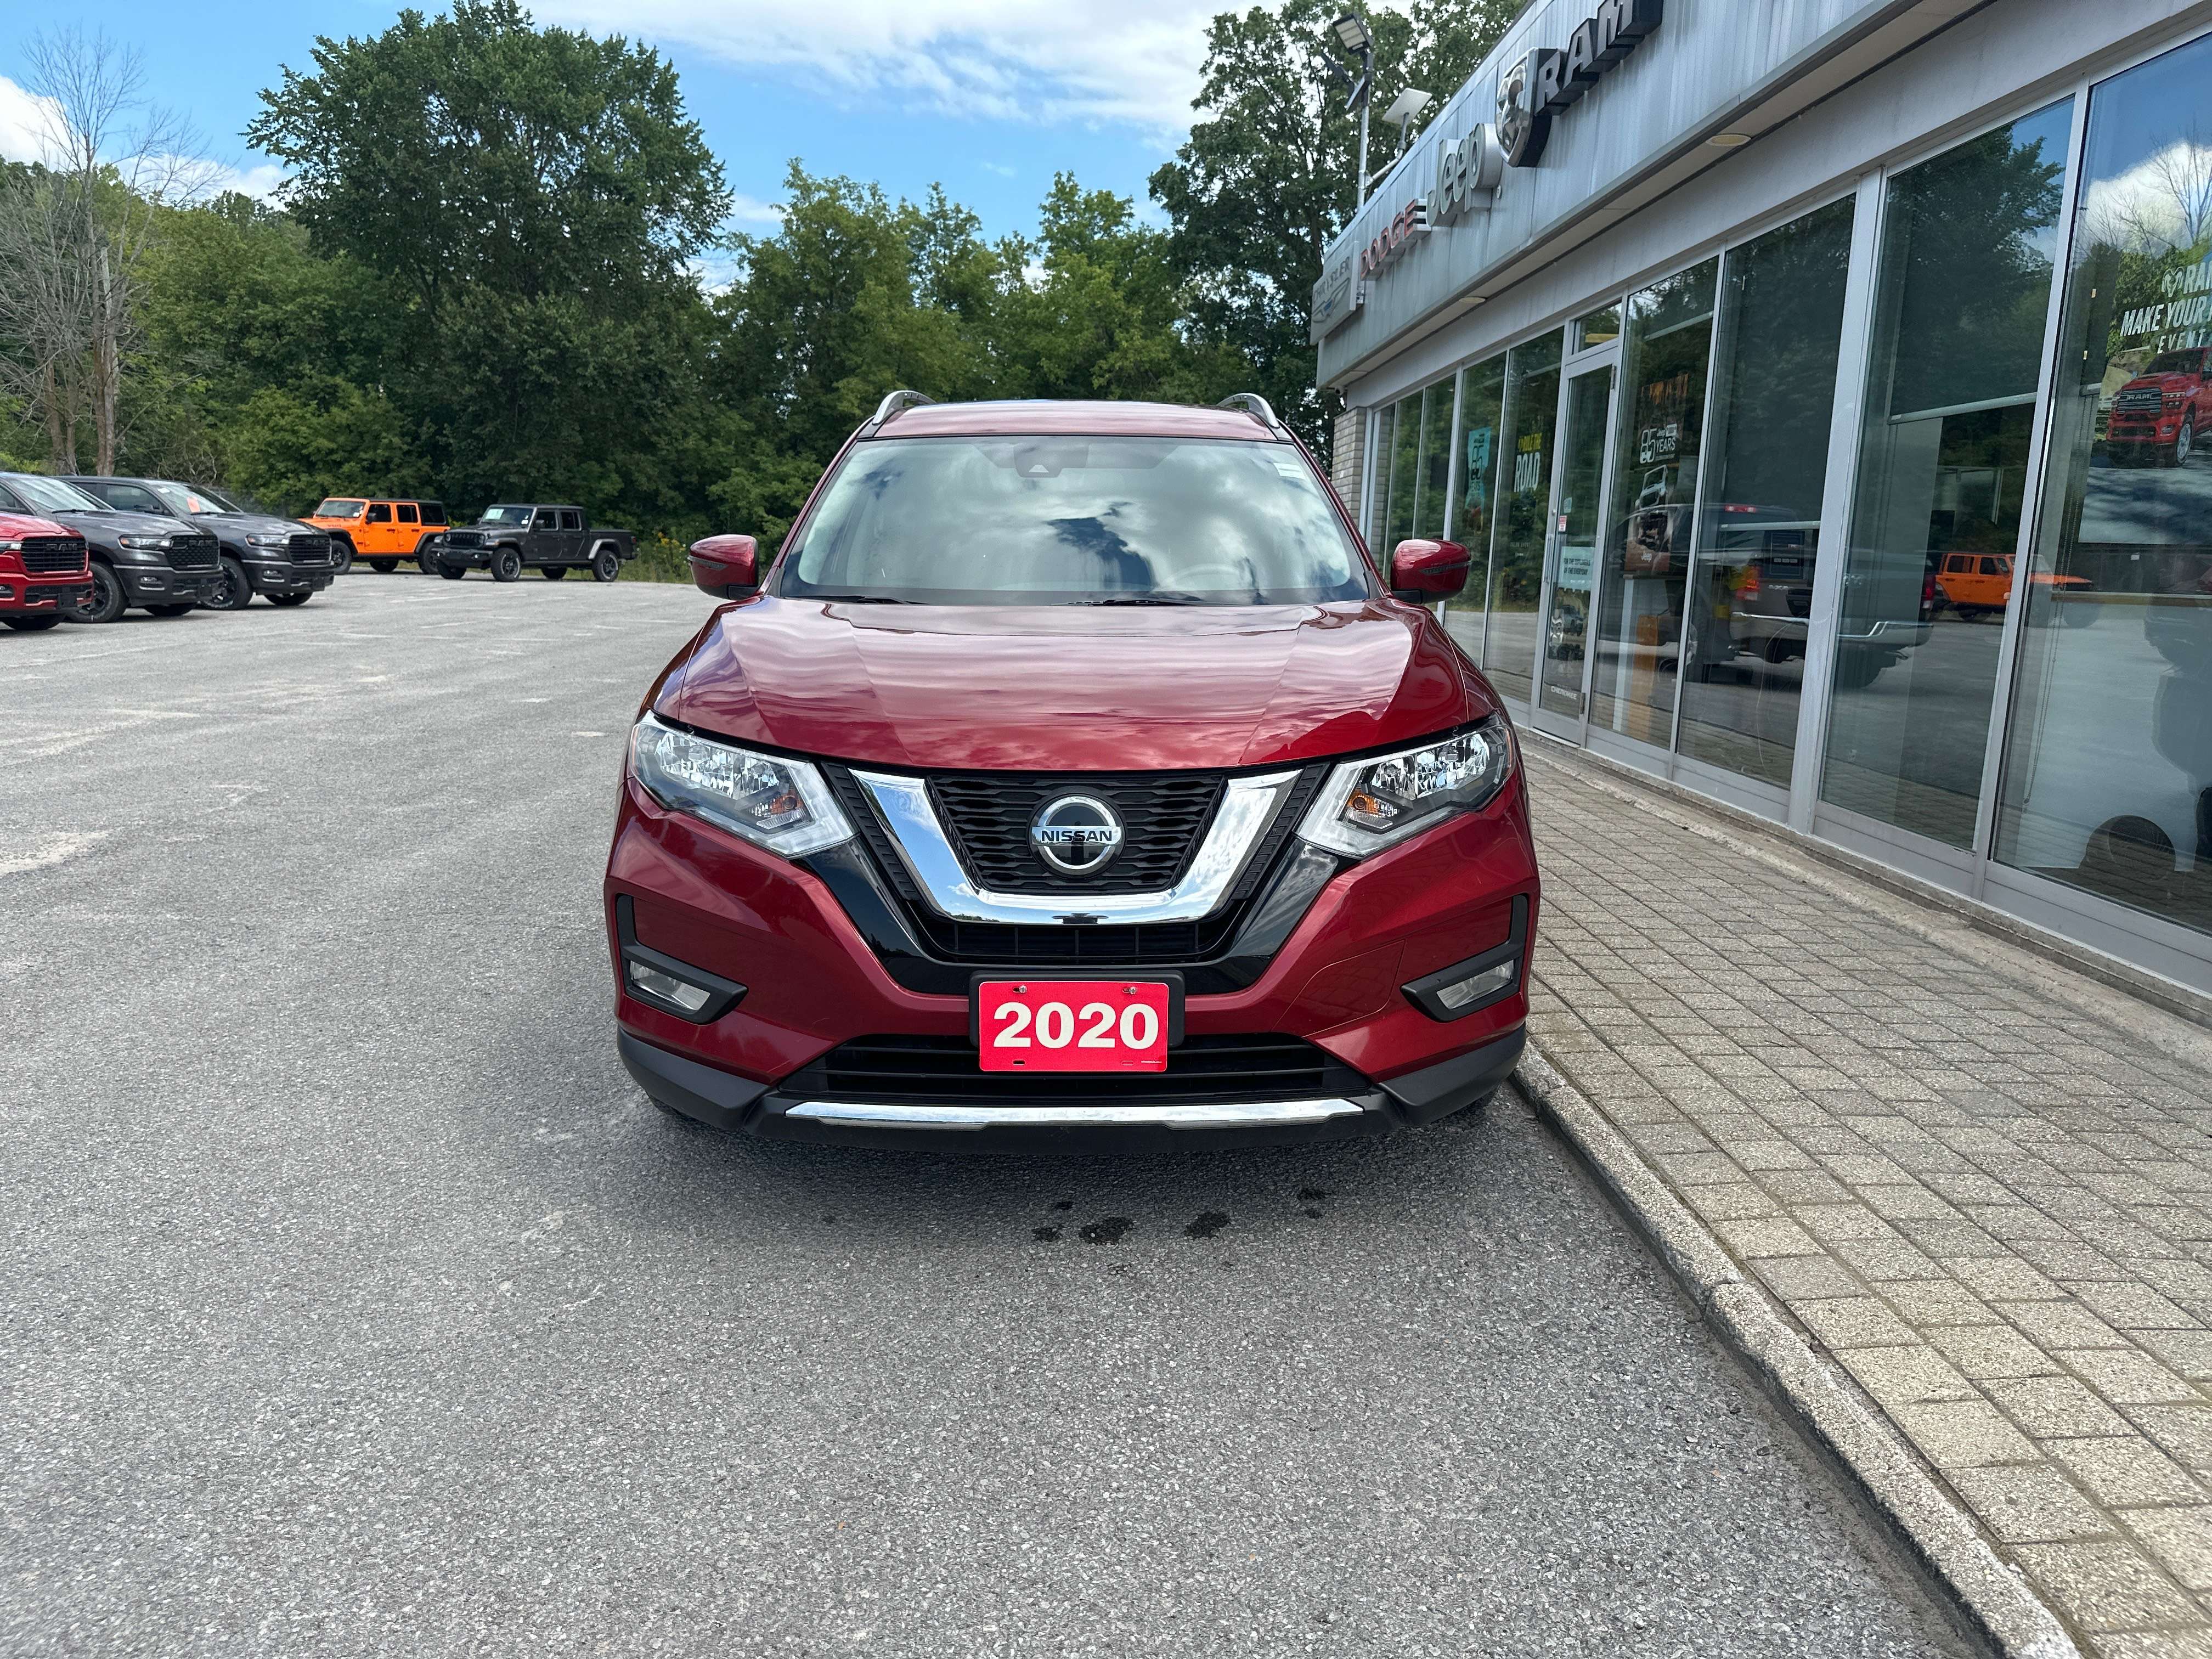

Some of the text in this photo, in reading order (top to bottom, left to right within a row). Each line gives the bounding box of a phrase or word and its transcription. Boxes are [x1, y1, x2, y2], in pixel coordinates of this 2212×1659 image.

[1535, 0, 1633, 115] RAM
[1426, 123, 1485, 227] Jeep
[1360, 199, 1416, 281] DODGE
[2120, 303, 2164, 337] MAKE
[2165, 296, 2207, 329] YOUR
[2157, 329, 2206, 354] EVENT
[2127, 392, 2151, 400] RAM
[1656, 437, 1675, 453] YEARS
[1514, 452, 1540, 492] ROAD
[1041, 830, 1113, 842] NISSAN
[993, 1002, 1159, 1049] 2020
